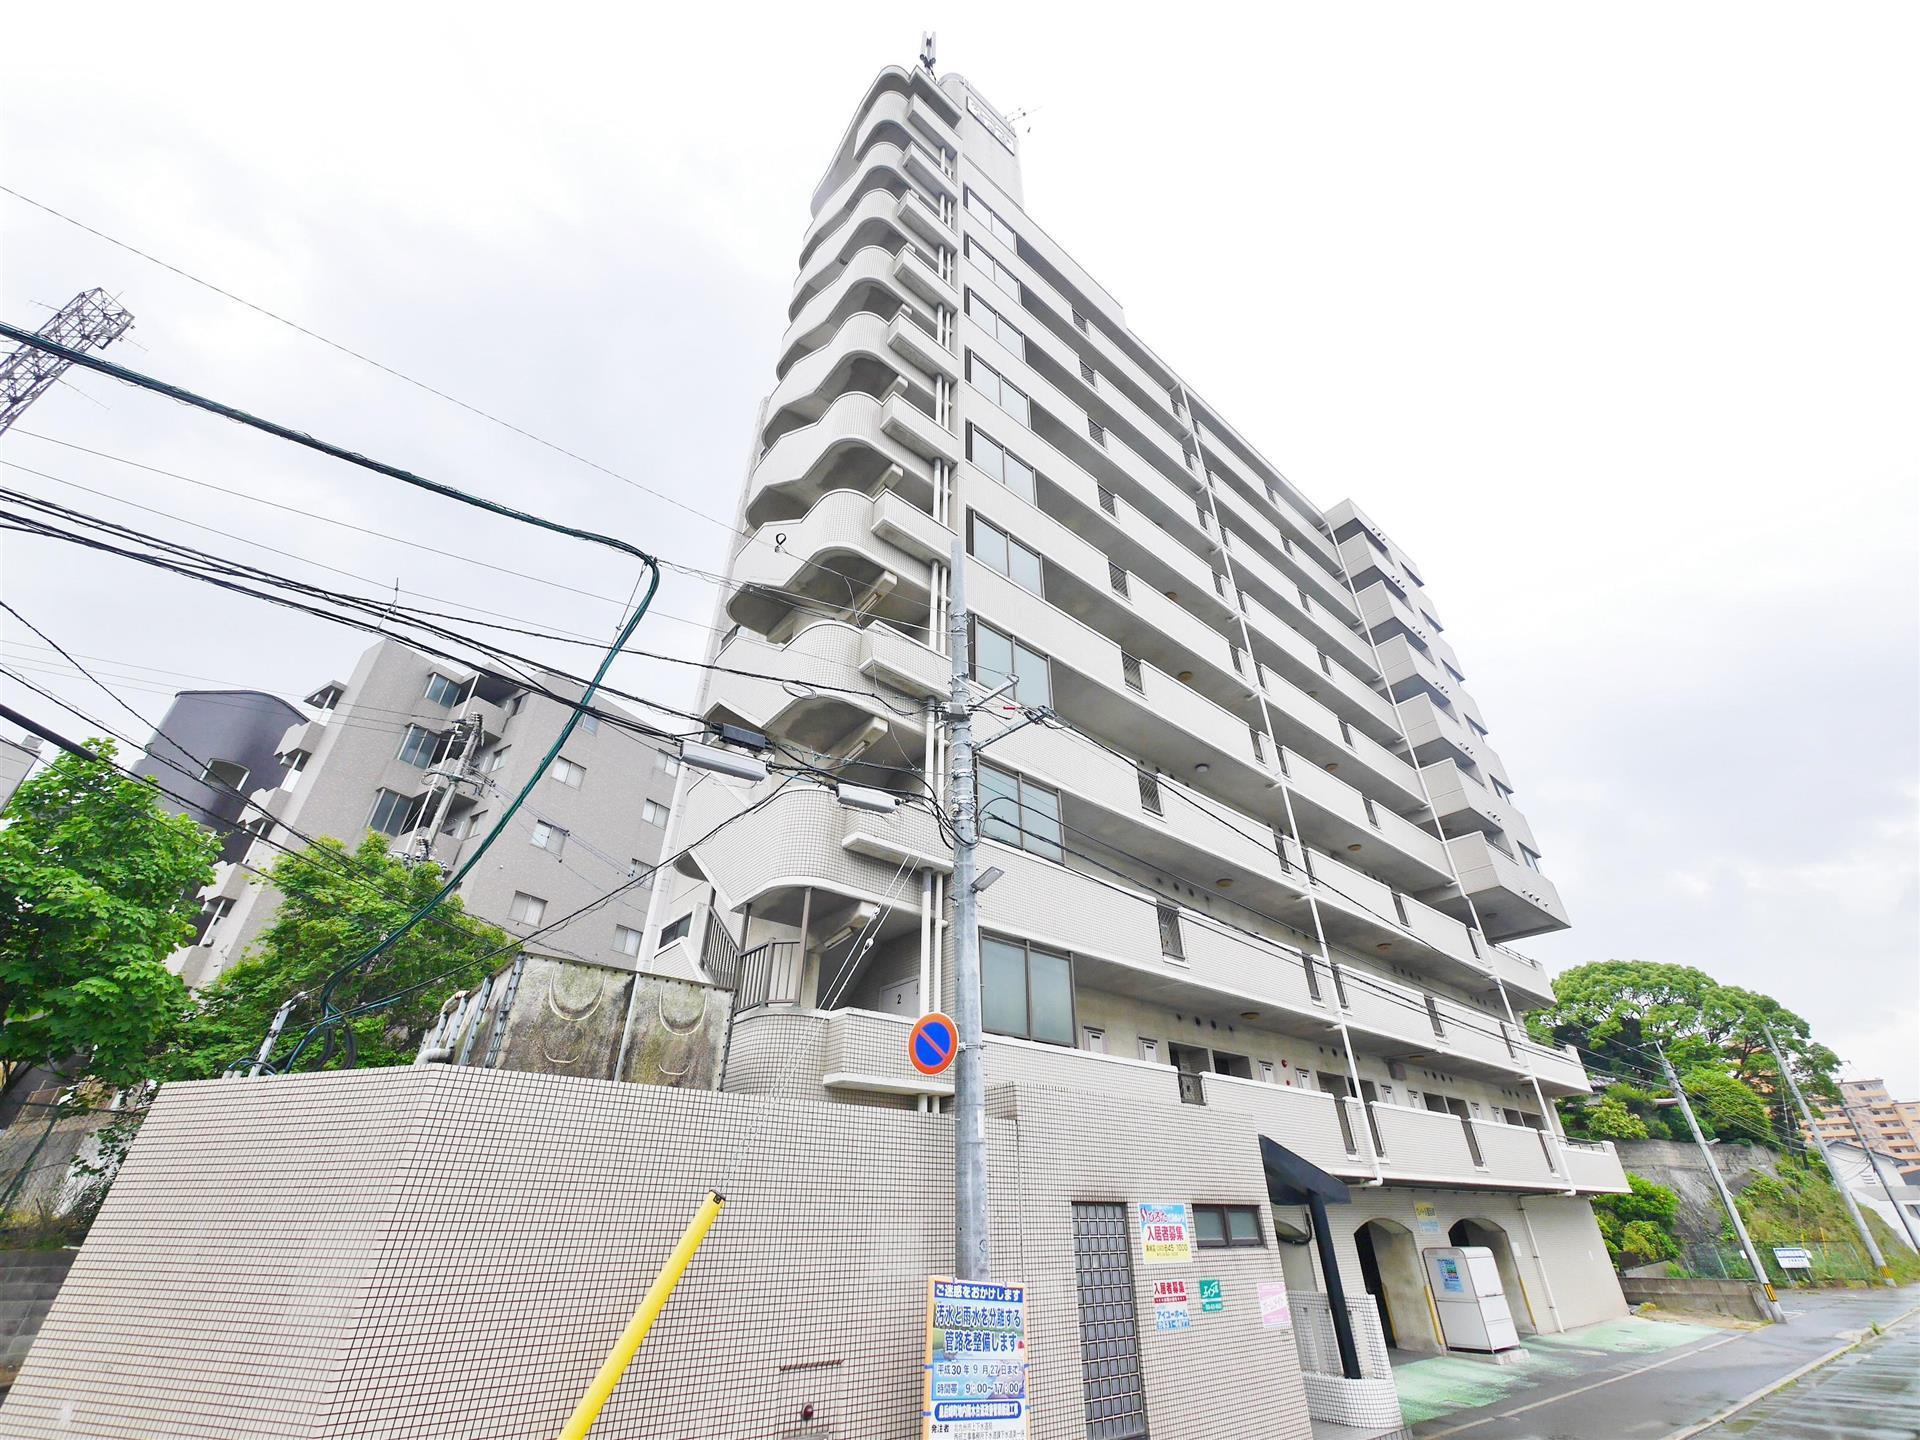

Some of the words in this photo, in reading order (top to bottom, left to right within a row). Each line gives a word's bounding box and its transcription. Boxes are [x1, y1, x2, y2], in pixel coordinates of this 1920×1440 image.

[1147, 1225, 1184, 1242] 入居者募集
[936, 1284, 1021, 1301] ご迷惑をおかけします
[1154, 1281, 1185, 1295] 入居者募集
[936, 1304, 1021, 1328] 汚水と雨水を分離する
[944, 1331, 1017, 1353] 管路を整備します
[937, 1383, 958, 1394] 時間帯
[931, 1424, 950, 1433] 発注者
